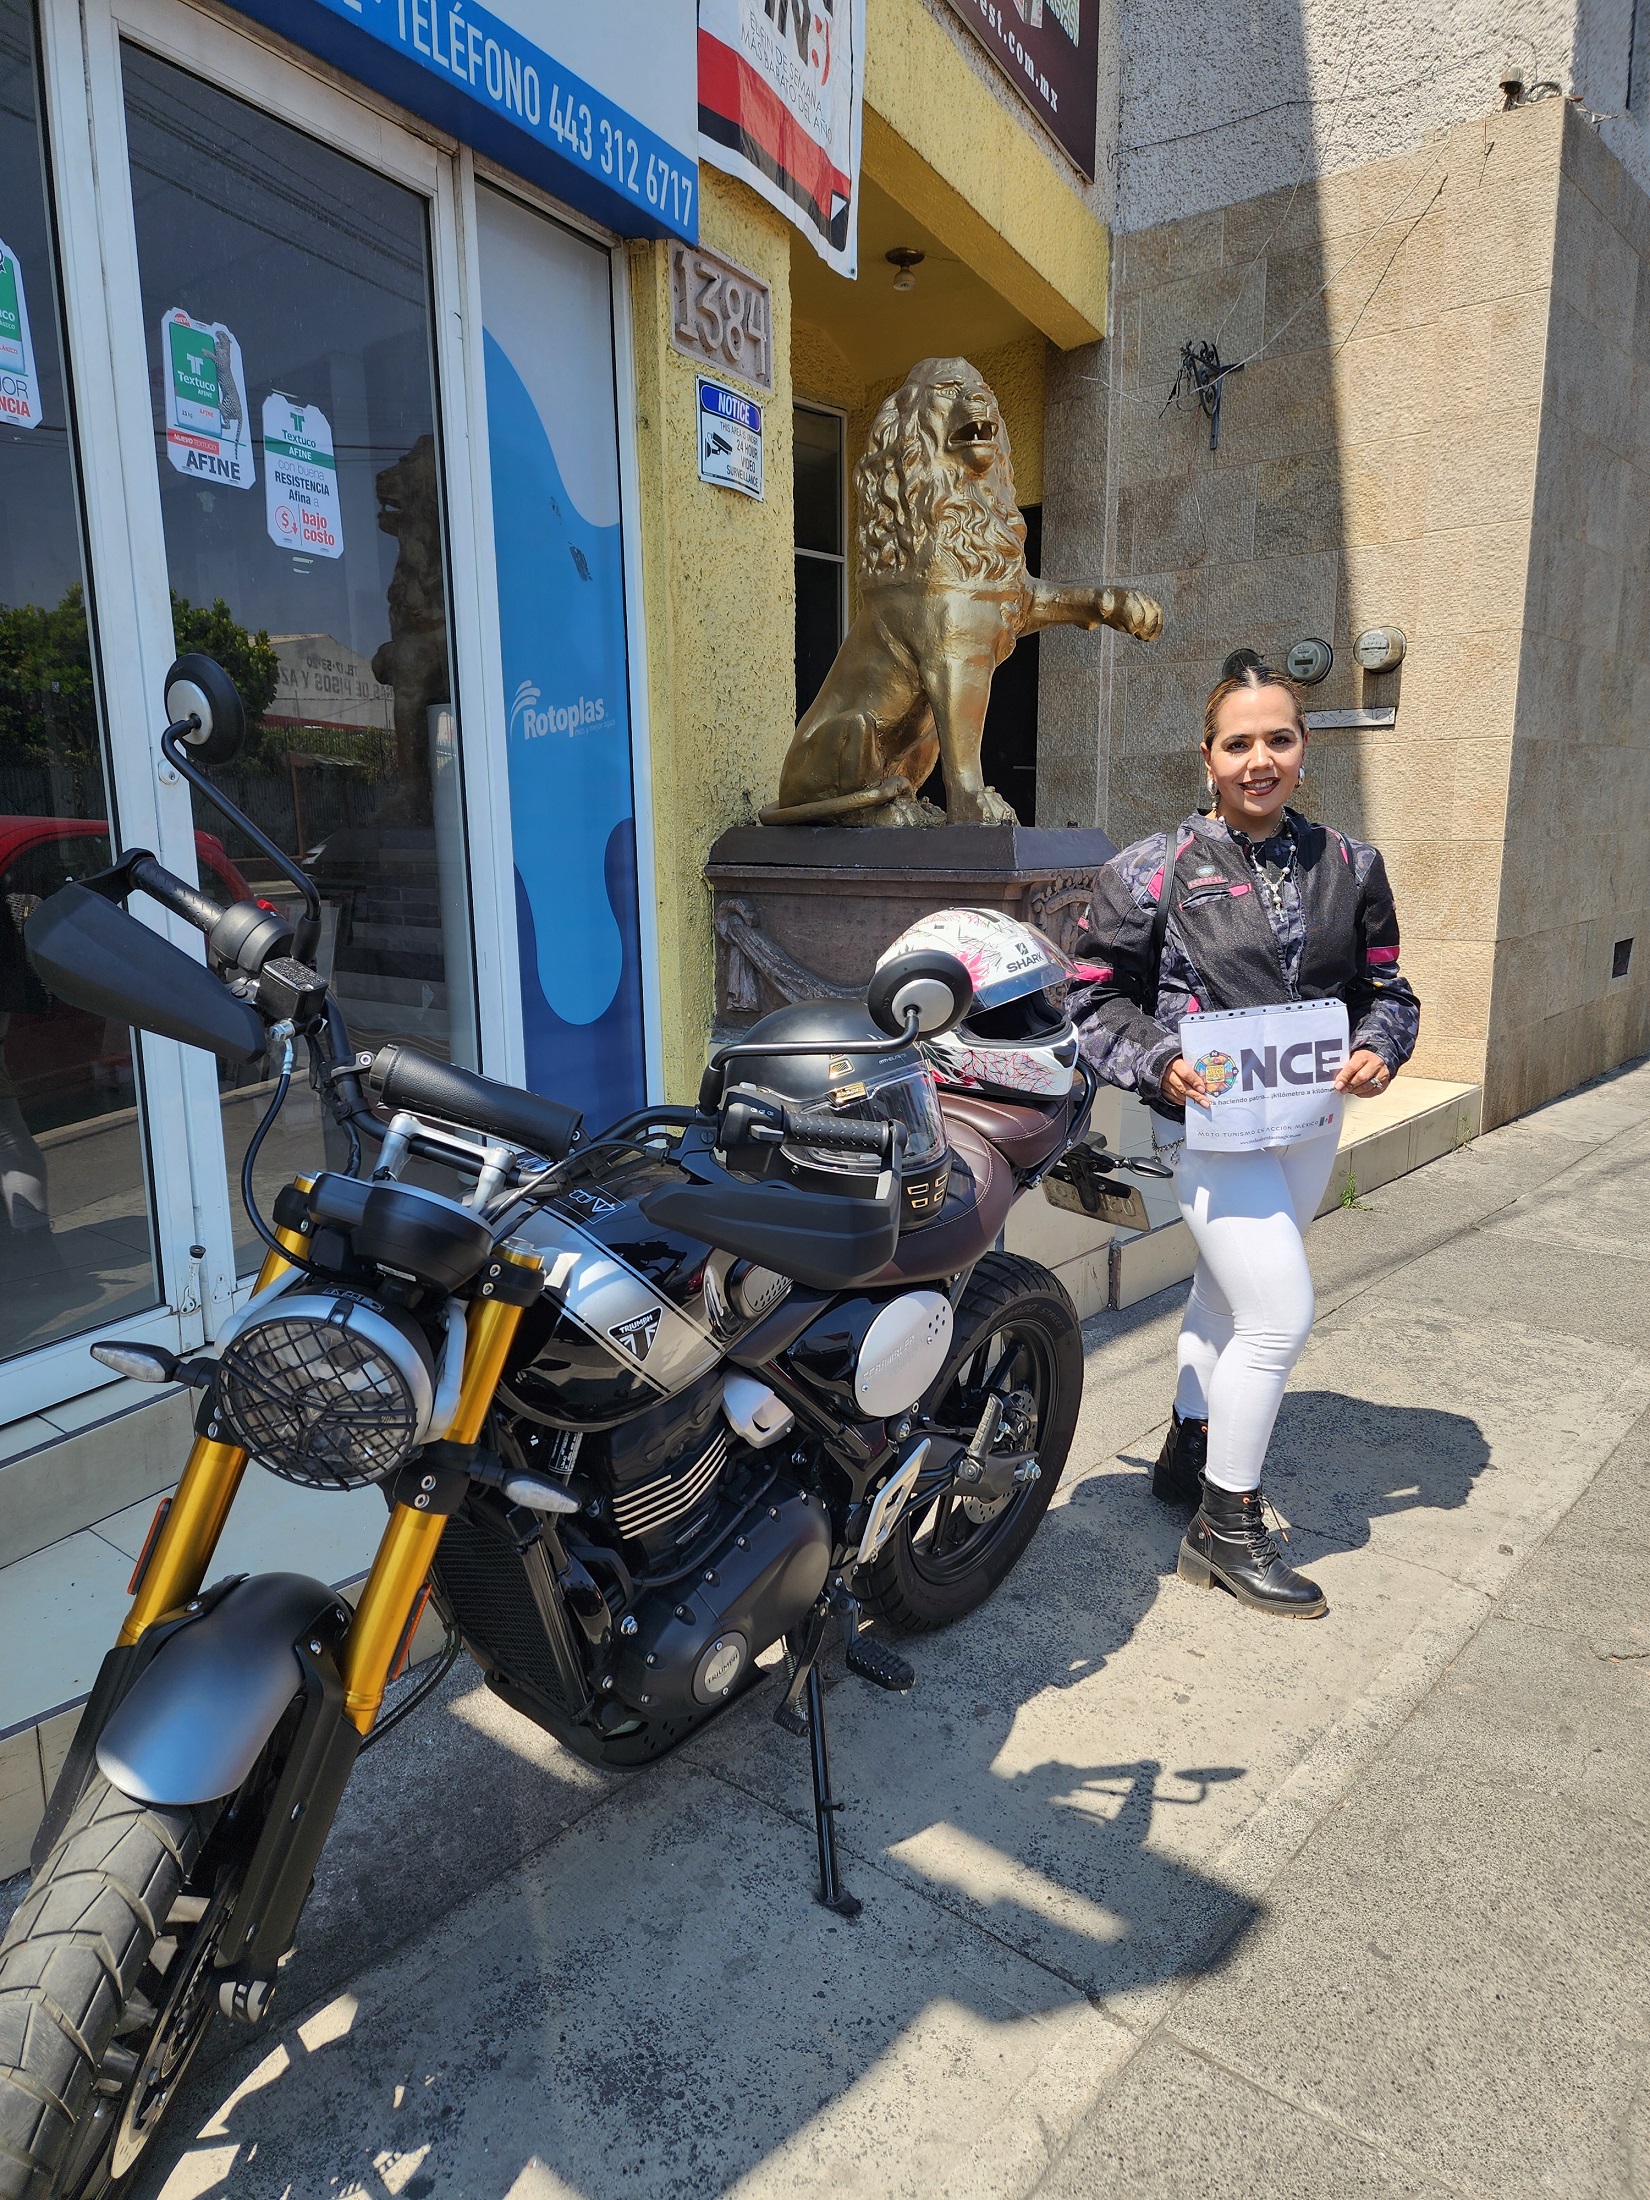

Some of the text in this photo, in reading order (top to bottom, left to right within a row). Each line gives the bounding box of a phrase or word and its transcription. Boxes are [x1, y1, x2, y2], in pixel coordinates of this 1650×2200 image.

[750, 10, 823, 117] EL FIN DE SEMANA
[973, 0, 1058, 113] est.com.mx
[741, 23, 833, 144] MÁS BARATO DEL AÑO
[549, 83, 593, 161] 443
[600, 119, 639, 194] 312
[646, 153, 692, 227] 6717
[675, 250, 767, 378] 1384
[178, 370, 216, 393] Textuco
[197, 389, 213, 399] AFINE
[718, 392, 750, 425] NOTICE
[173, 433, 217, 451] NUEVO TEXTUCO
[281, 429, 316, 448] Textuco
[720, 420, 758, 446] THIS AREA IS UNDER
[288, 446, 312, 461] AFINE
[736, 439, 759, 460] 24 HOUR
[186, 450, 242, 481] AFINE
[278, 459, 325, 482] con buena
[726, 464, 759, 488] SURVEILLANCE
[740, 455, 756, 474] VIDEO
[274, 470, 330, 496] RESISTENCIA
[288, 488, 320, 507] Afina a
[301, 508, 328, 531] bajo
[303, 527, 335, 546] costo
[523, 695, 605, 740] Rotoplas
[1006, 951, 1044, 973] SHARK
[1217, 1096, 1248, 1106] haciendo
[1222, 1129, 1256, 1138] TURISMO
[1265, 1123, 1292, 1132] ACCIÓN
[1294, 1120, 1319, 1129] MÉXICO
[619, 1314, 653, 1334] TRIUMPH
[708, 1653, 738, 1684] TRIUMPH
